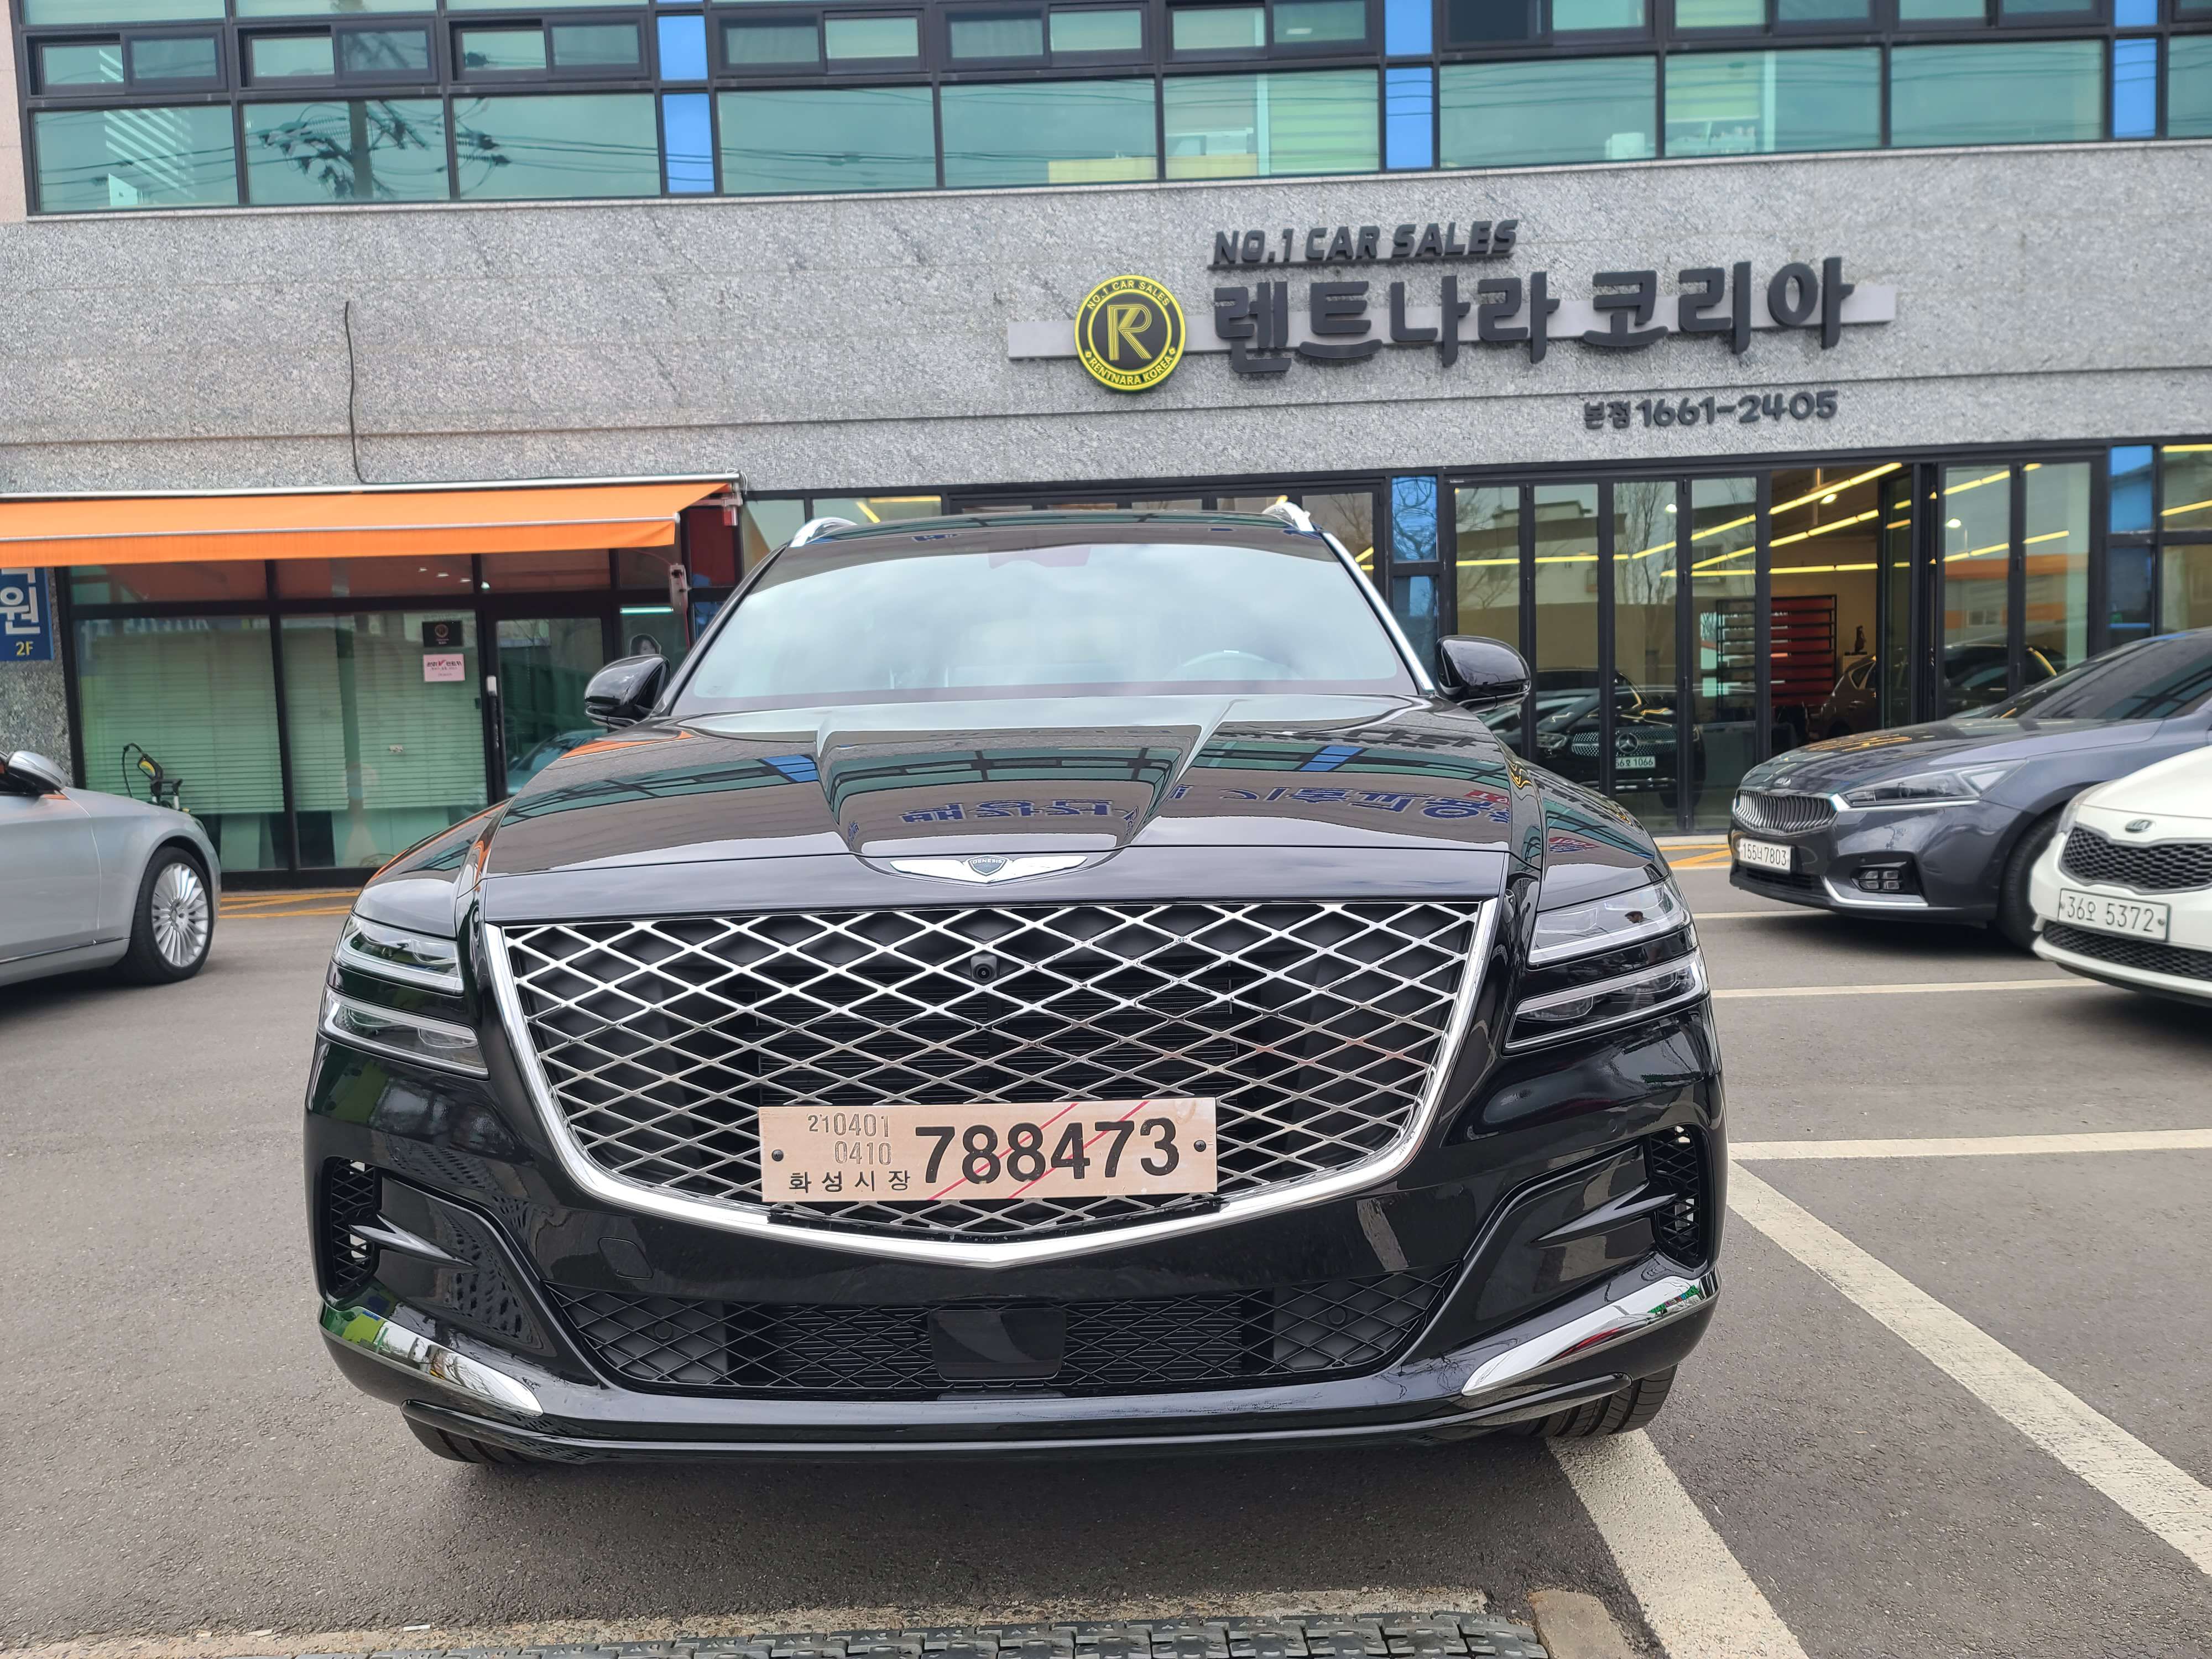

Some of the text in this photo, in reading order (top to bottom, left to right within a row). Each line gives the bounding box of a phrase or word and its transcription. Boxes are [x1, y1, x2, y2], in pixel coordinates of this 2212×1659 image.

[1213, 220, 1519, 264] NO.1 CAR SALES
[1112, 280, 1134, 290] CAR
[1139, 282, 1170, 306] SALES
[1215, 257, 1855, 373] 렌트나라 코리아
[1107, 304, 1152, 361] R
[1089, 356, 1173, 385] RENTNARA KOREA
[15, 641, 34, 656] 2F
[1634, 757, 1653, 766] 1066
[2068, 896, 2154, 932] 36오 5372
[807, 1113, 889, 1138] 210401
[834, 1140, 893, 1165] 0410
[915, 1117, 1180, 1185] 788473
